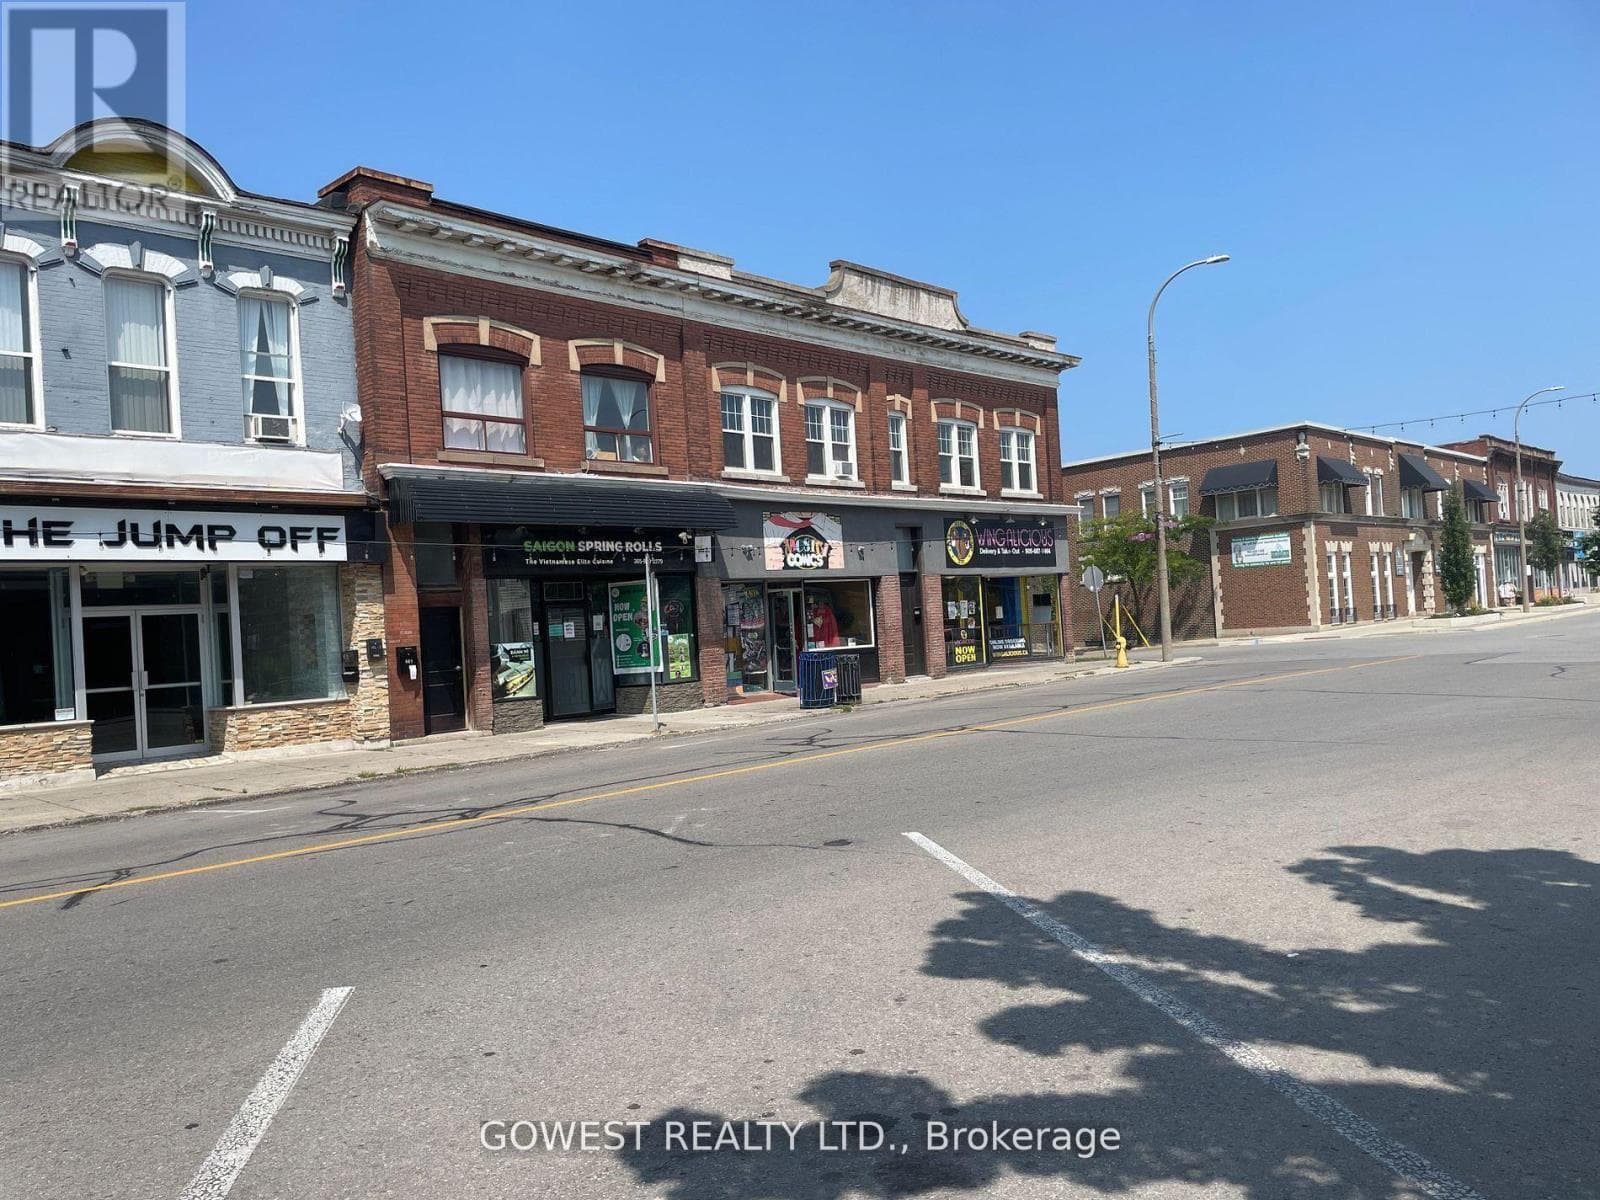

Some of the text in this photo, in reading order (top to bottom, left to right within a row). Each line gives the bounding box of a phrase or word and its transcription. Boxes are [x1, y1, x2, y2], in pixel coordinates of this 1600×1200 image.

[103, 519, 236, 552] JUMP
[258, 526, 341, 553] OFF
[523, 540, 662, 553] SAIGON SPRING ROLLS
[787, 553, 824, 567] COMICS
[614, 602, 630, 611] NOW
[613, 613, 633, 622] OPEN
[955, 645, 975, 655] NOW
[955, 654, 976, 663] OPEN
